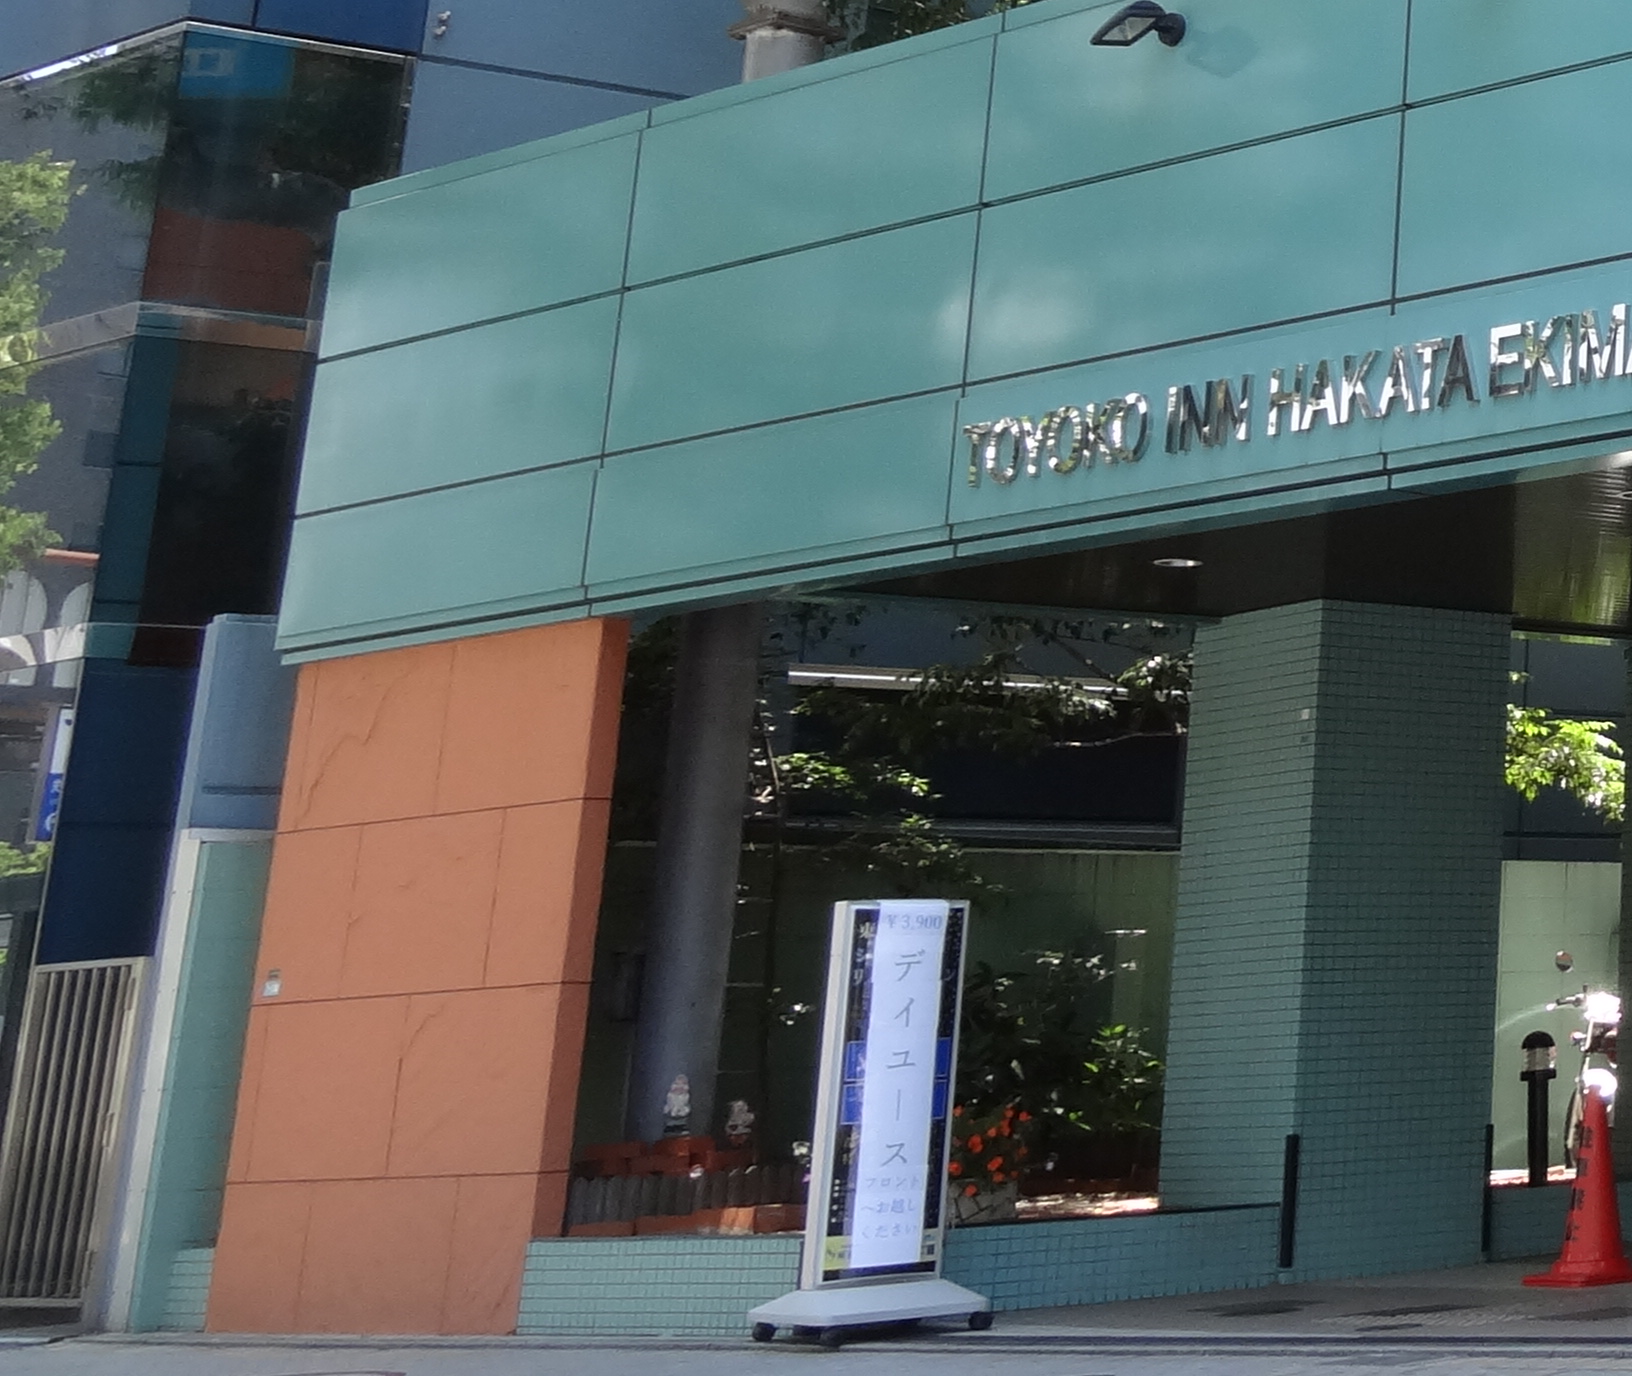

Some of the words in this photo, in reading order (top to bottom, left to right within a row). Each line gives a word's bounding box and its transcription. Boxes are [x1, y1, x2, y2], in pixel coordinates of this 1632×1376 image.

[961, 392, 1152, 489] TOYOKO
[1164, 373, 1252, 455] INN
[1267, 334, 1480, 437] HAKATA
[879, 948, 926, 1167] デイユース
